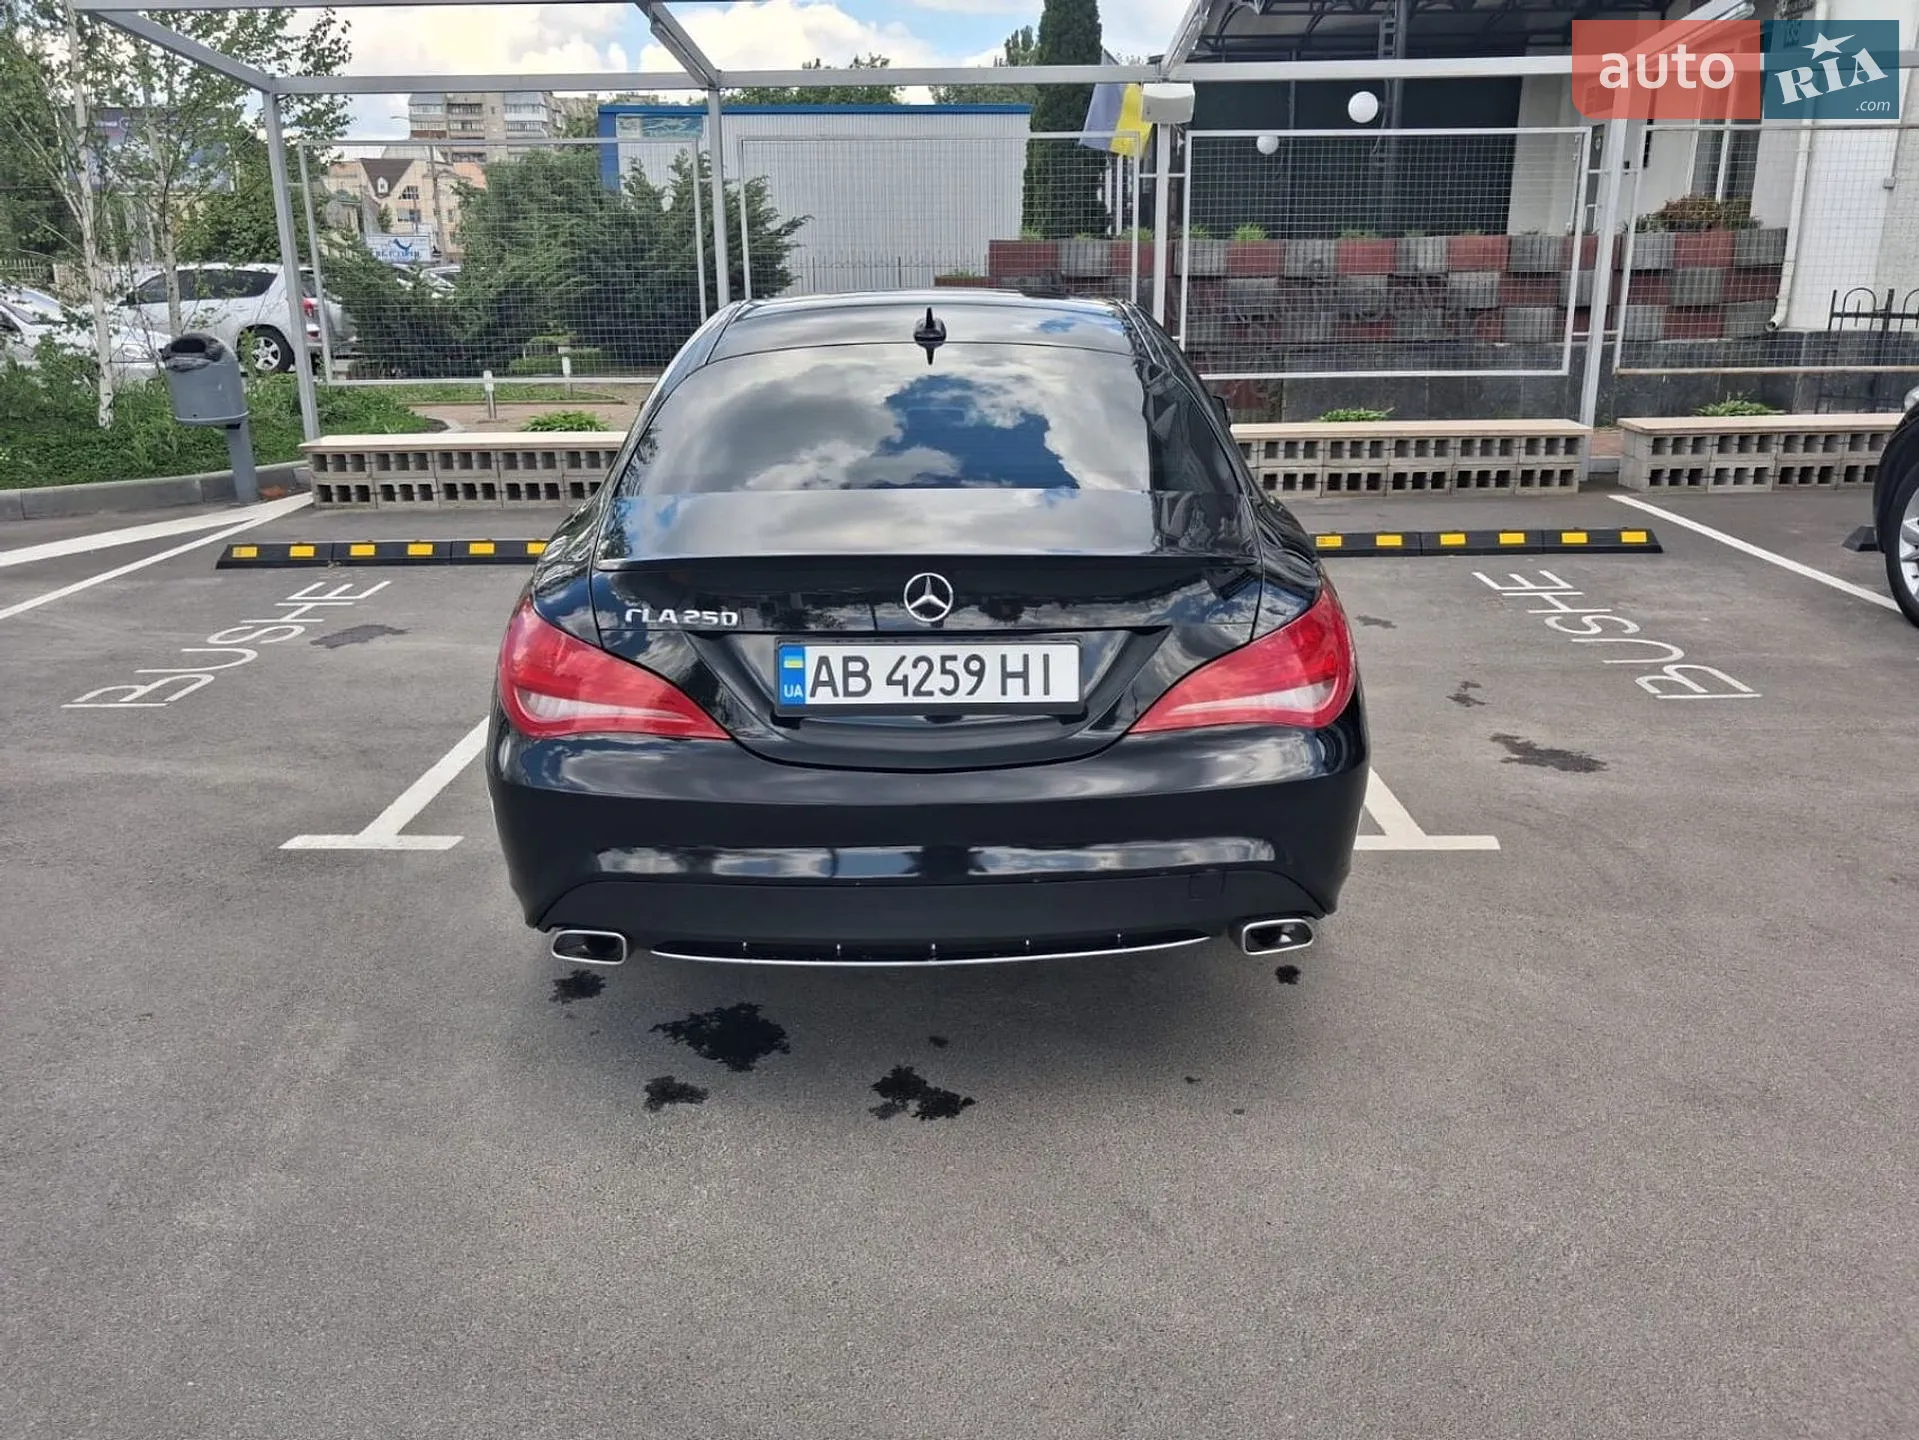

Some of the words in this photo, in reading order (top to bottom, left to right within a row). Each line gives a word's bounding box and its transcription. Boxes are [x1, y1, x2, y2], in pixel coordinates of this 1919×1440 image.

[60, 580, 392, 708] BUSHE
[809, 655, 872, 698] AB
[885, 653, 986, 697] 4259
[1000, 653, 1050, 696] HI
[1472, 570, 1763, 700] BUSHE
[783, 684, 804, 698] UA
